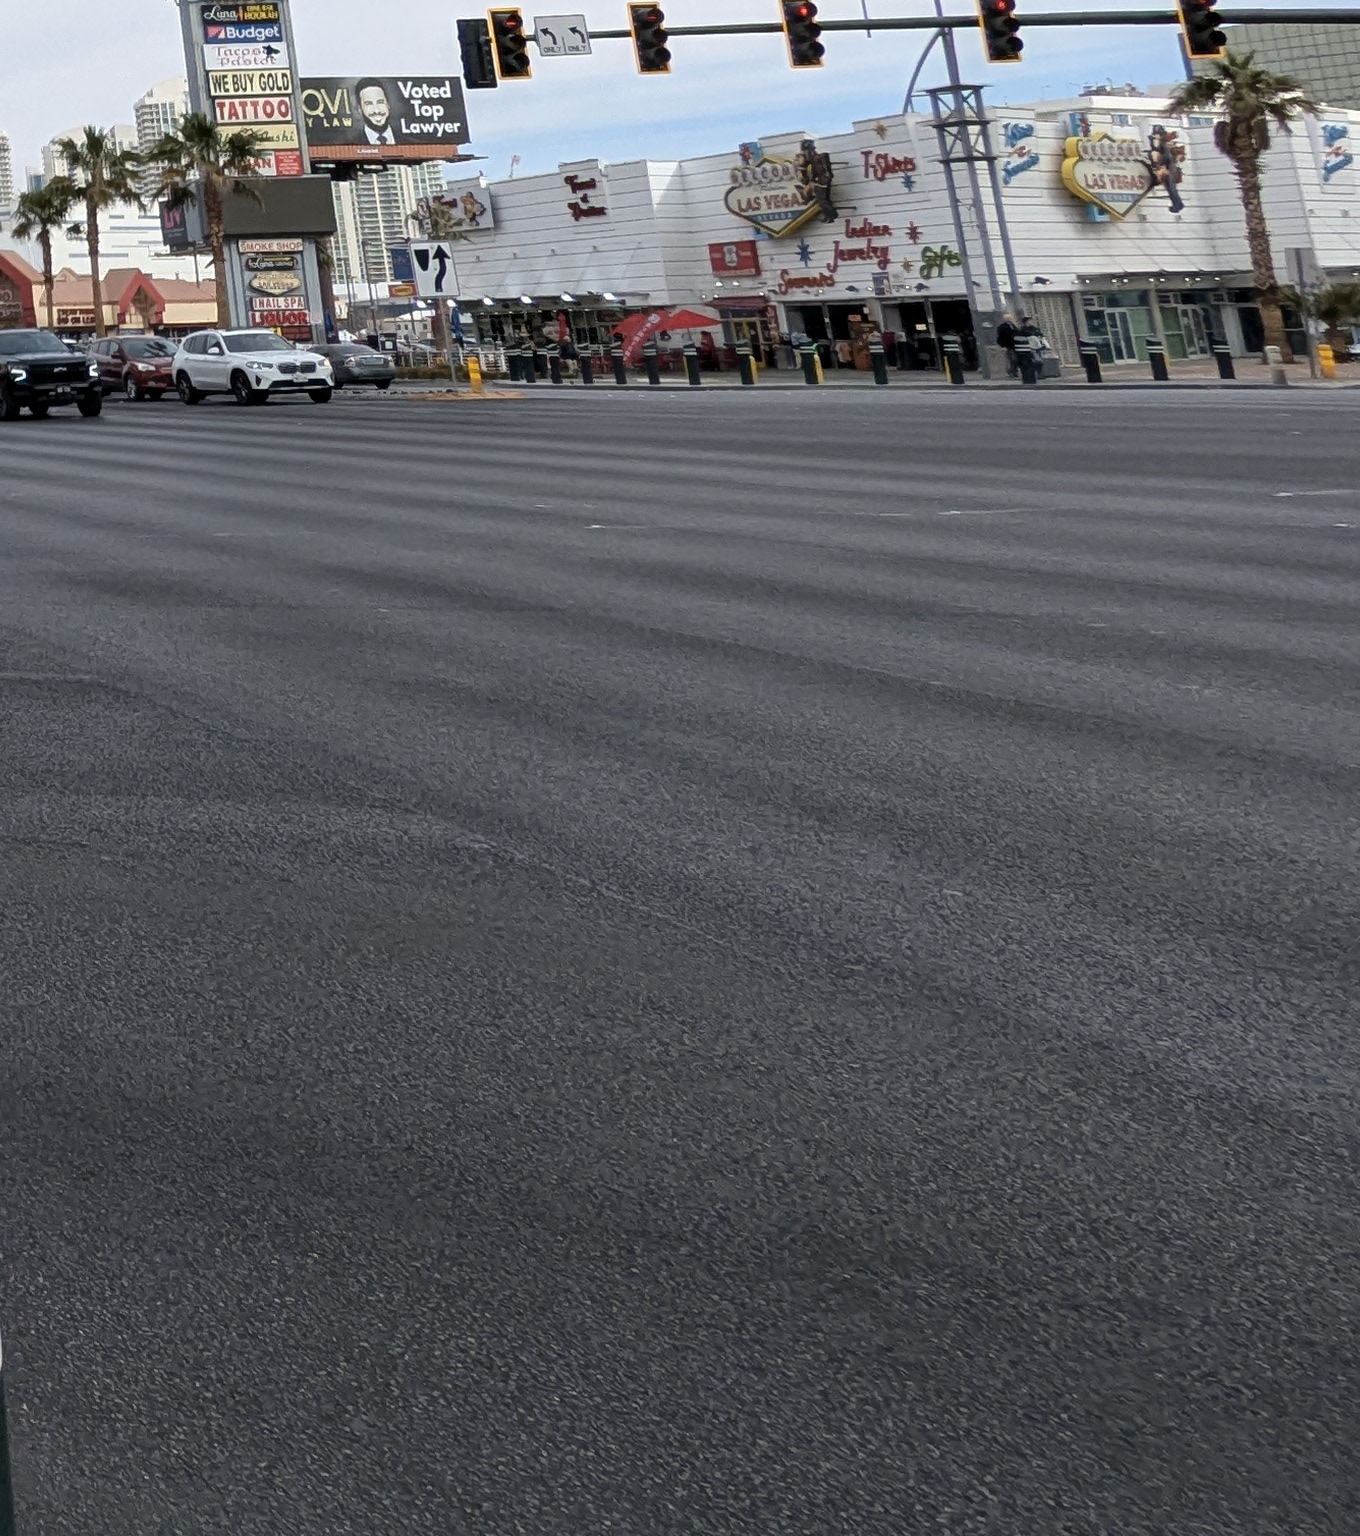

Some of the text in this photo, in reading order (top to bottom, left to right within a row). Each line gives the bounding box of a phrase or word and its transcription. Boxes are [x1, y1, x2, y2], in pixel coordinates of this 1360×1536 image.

[226, 25, 281, 41] Budget
[543, 46, 561, 54] ONLY
[211, 72, 290, 94] WE BUY GOLD
[397, 80, 452, 99] Voted
[216, 99, 290, 121] TATTOO
[301, 88, 352, 117] QVI
[410, 100, 444, 121] Top
[324, 117, 353, 127] LAW
[401, 118, 461, 137] Lawyer
[1084, 173, 1147, 190] LAS VEGAS
[737, 196, 761, 212] LAS
[241, 241, 303, 251] SMOKE SHOP
[283, 298, 305, 308] SPA
[251, 311, 308, 325] LIQUOR
